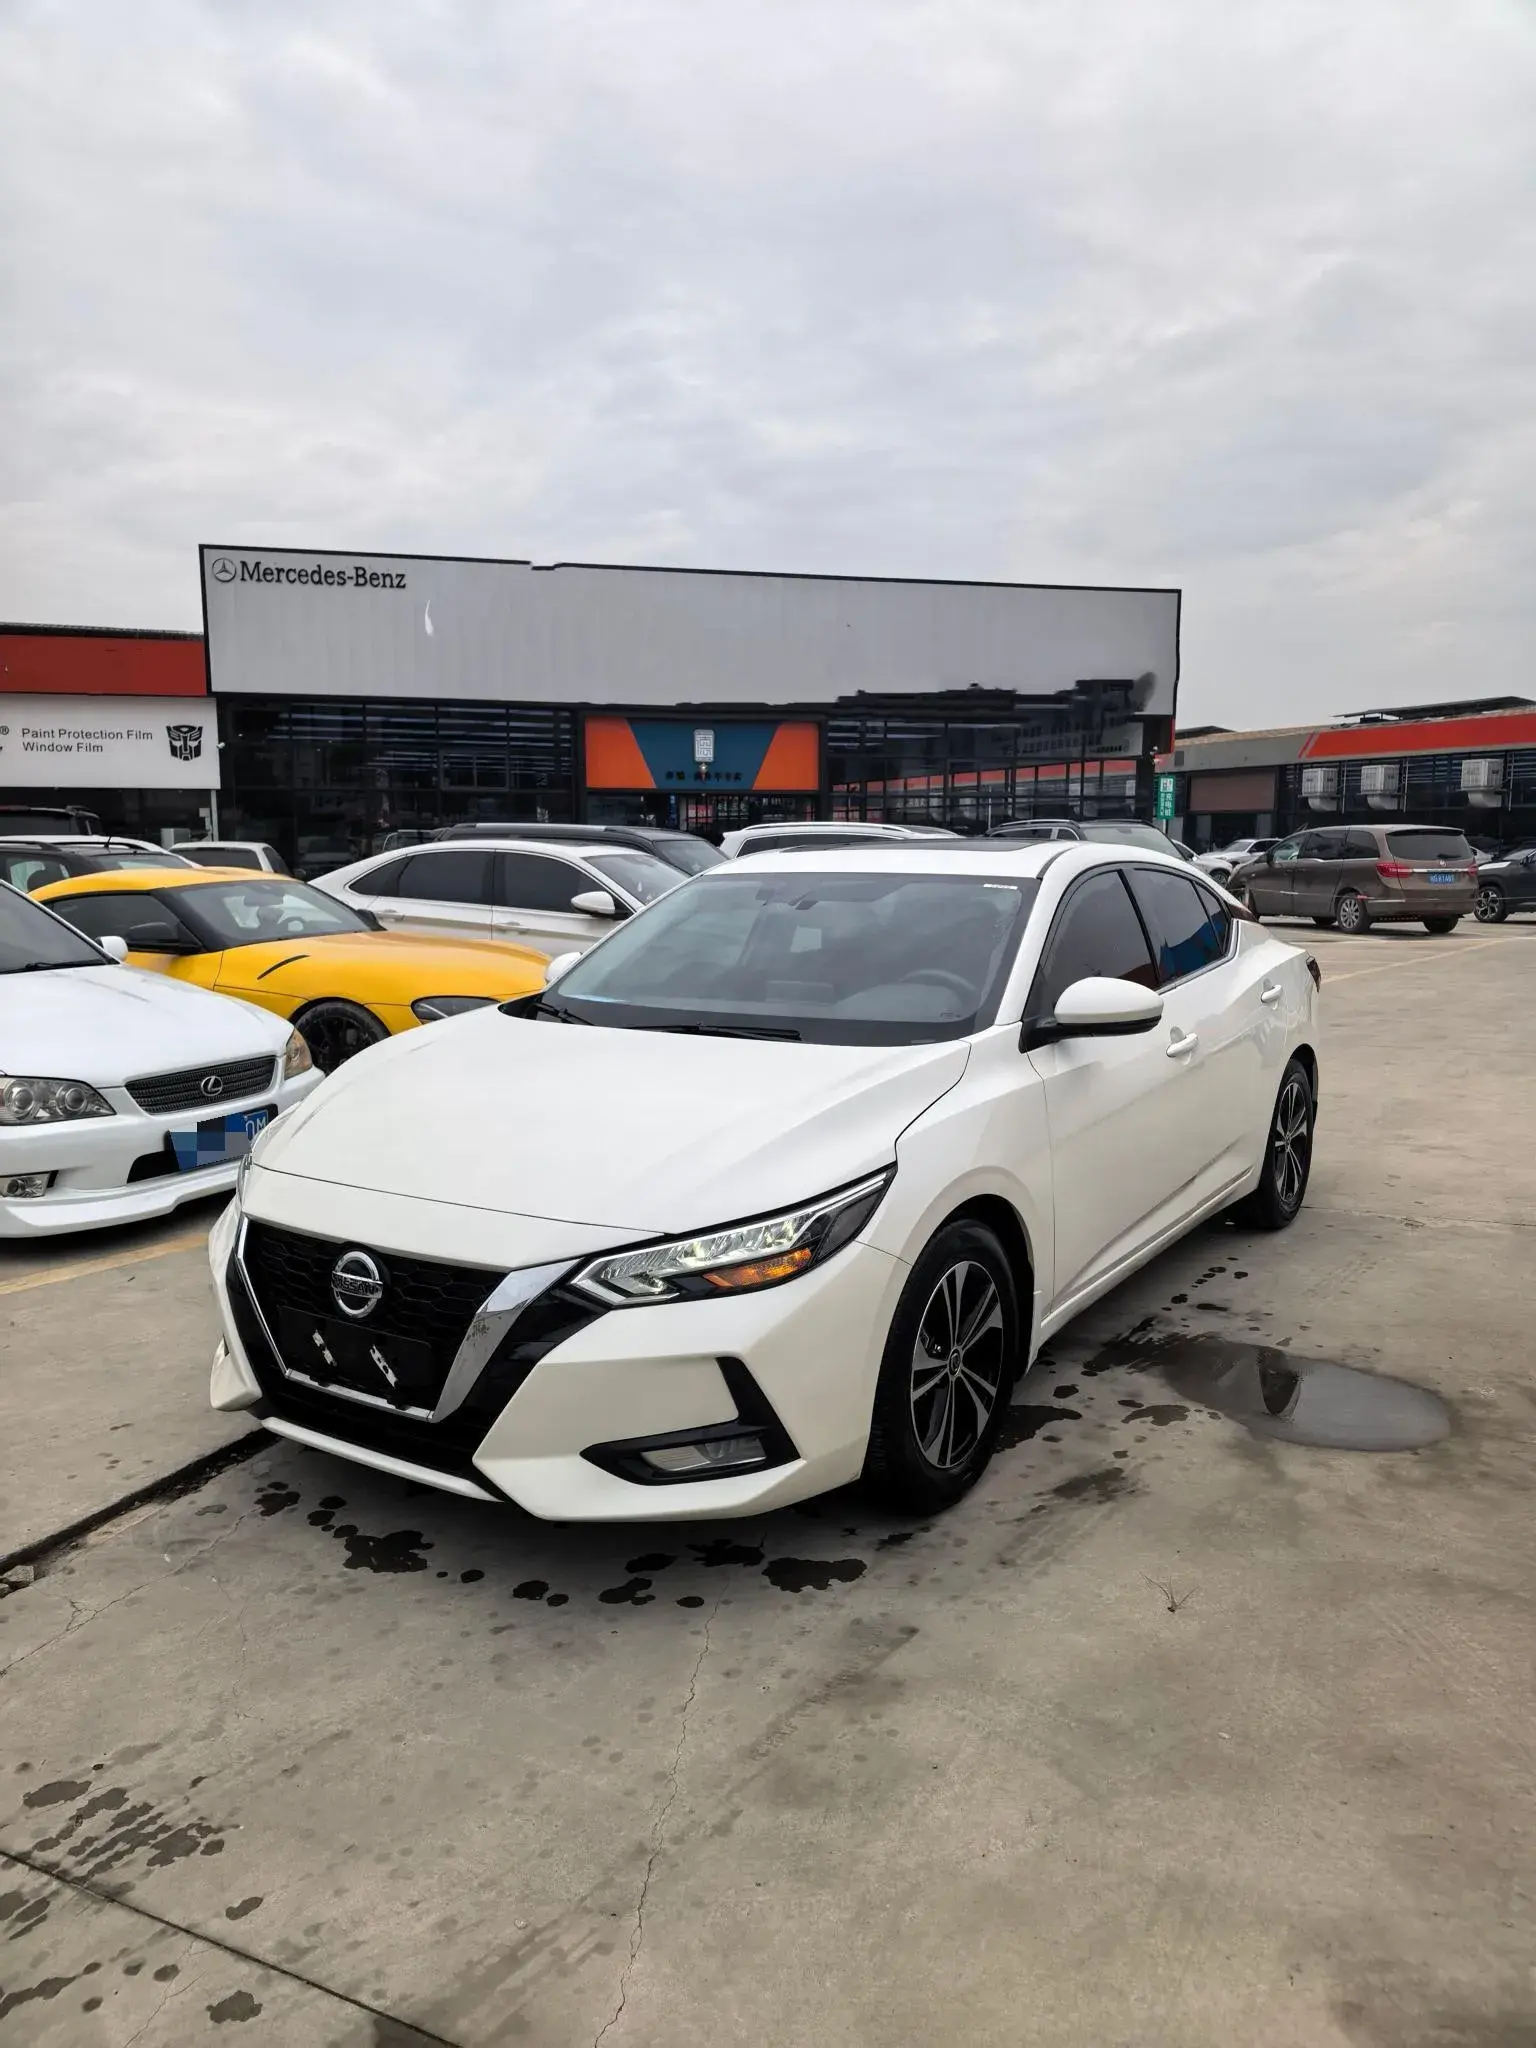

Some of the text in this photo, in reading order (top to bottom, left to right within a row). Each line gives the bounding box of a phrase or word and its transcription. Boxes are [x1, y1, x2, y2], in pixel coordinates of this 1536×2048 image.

[240, 560, 407, 589] Mercedes-Benz
[21, 727, 55, 739] Paint
[58, 728, 123, 740] Protection
[126, 729, 153, 740] Film
[22, 741, 104, 753] Window Film
[333, 1273, 381, 1297] NISSAN
